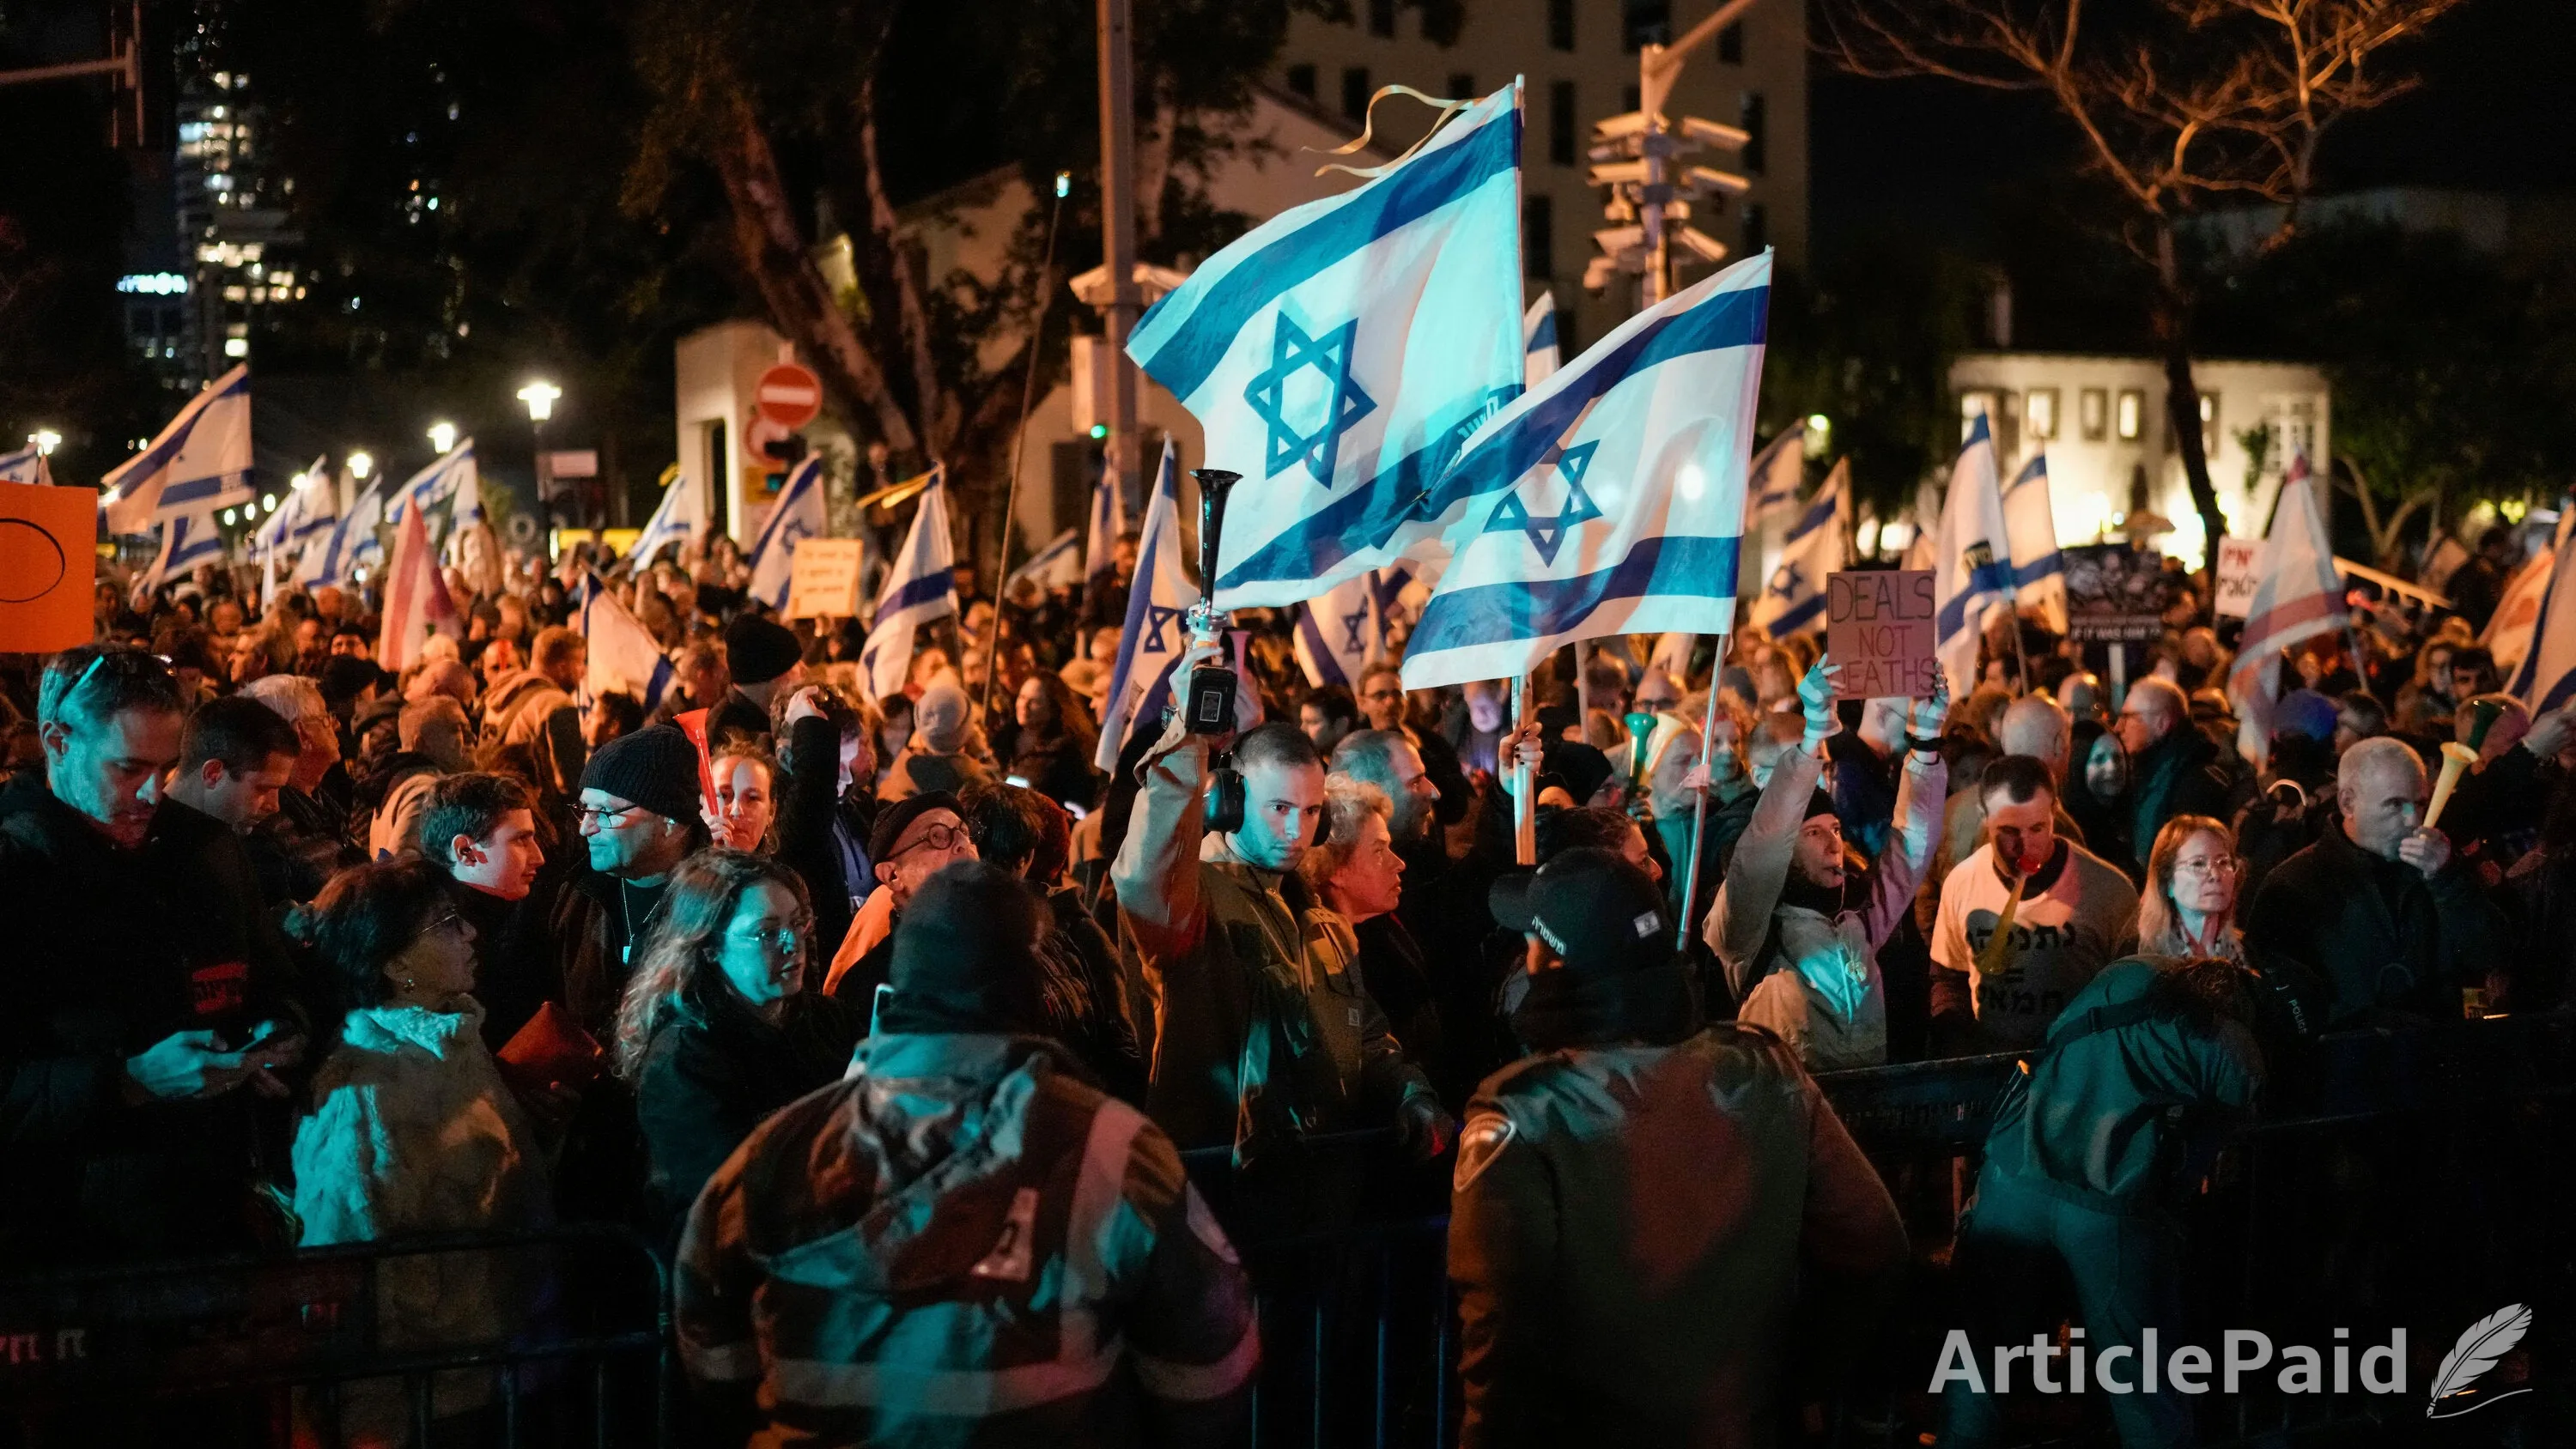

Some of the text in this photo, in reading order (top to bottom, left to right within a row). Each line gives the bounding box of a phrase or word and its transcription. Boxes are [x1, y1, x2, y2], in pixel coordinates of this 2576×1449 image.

[1830, 574, 1935, 623] DEALS
[1858, 625, 1912, 658] NOT
[1531, 913, 1568, 956] משטרה
[2287, 997, 2309, 1035] POLICE
